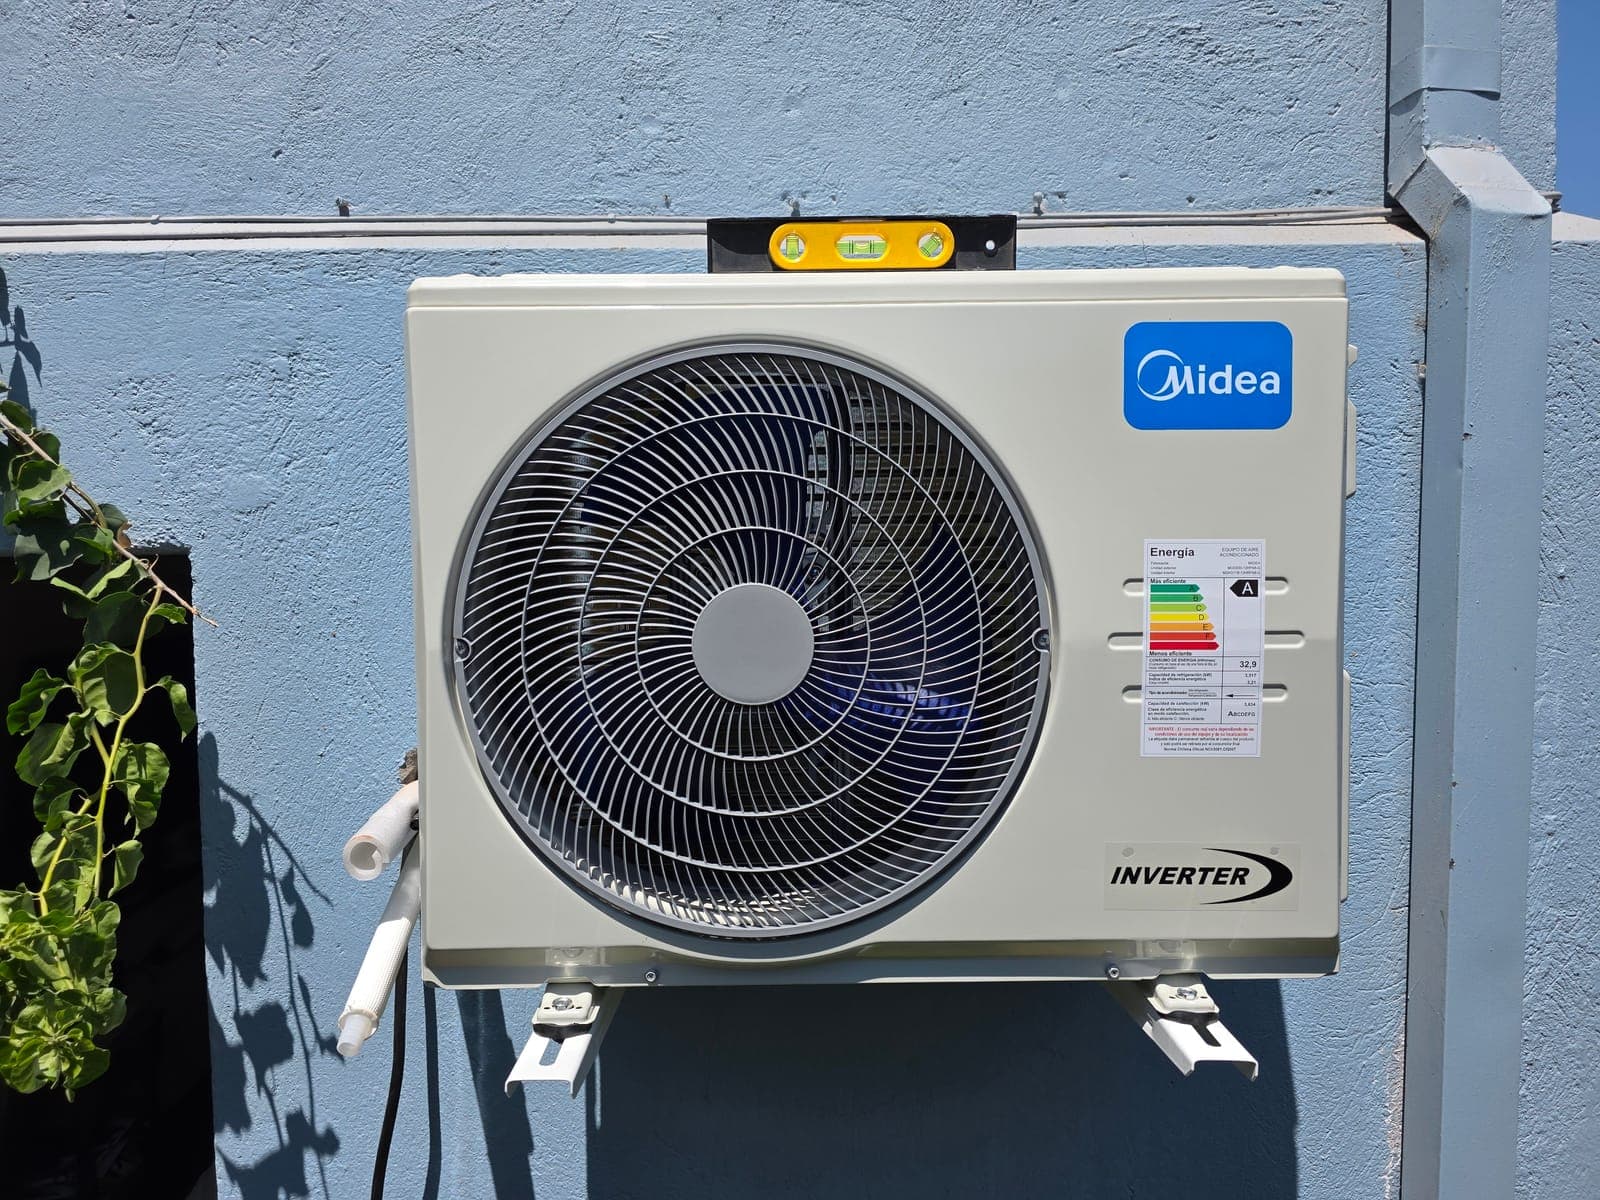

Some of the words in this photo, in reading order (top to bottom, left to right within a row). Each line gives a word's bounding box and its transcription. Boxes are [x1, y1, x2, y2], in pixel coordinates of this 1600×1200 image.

[1138, 364, 1281, 401] Midea
[1150, 547, 1195, 558] Energía
[1242, 582, 1254, 594] A
[1240, 661, 1257, 669] 32,9
[1110, 866, 1250, 885] INVERTER
